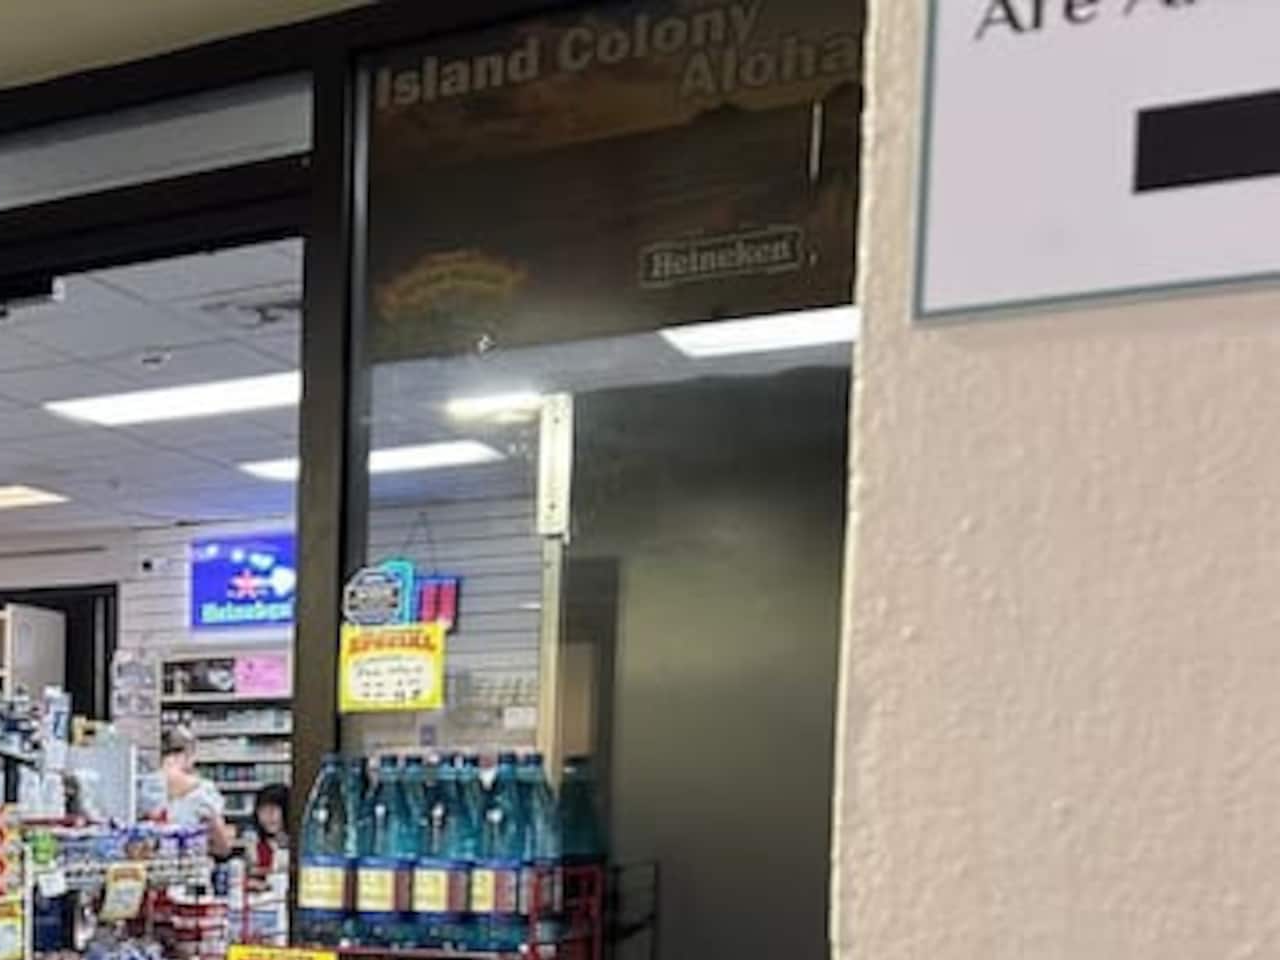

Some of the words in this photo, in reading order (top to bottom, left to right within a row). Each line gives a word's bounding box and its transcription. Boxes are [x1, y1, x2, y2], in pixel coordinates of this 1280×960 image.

[375, 38, 540, 107] Island
[559, 2, 763, 71] Colony
[680, 32, 859, 98] Aloha
[651, 238, 792, 278] Heineken
